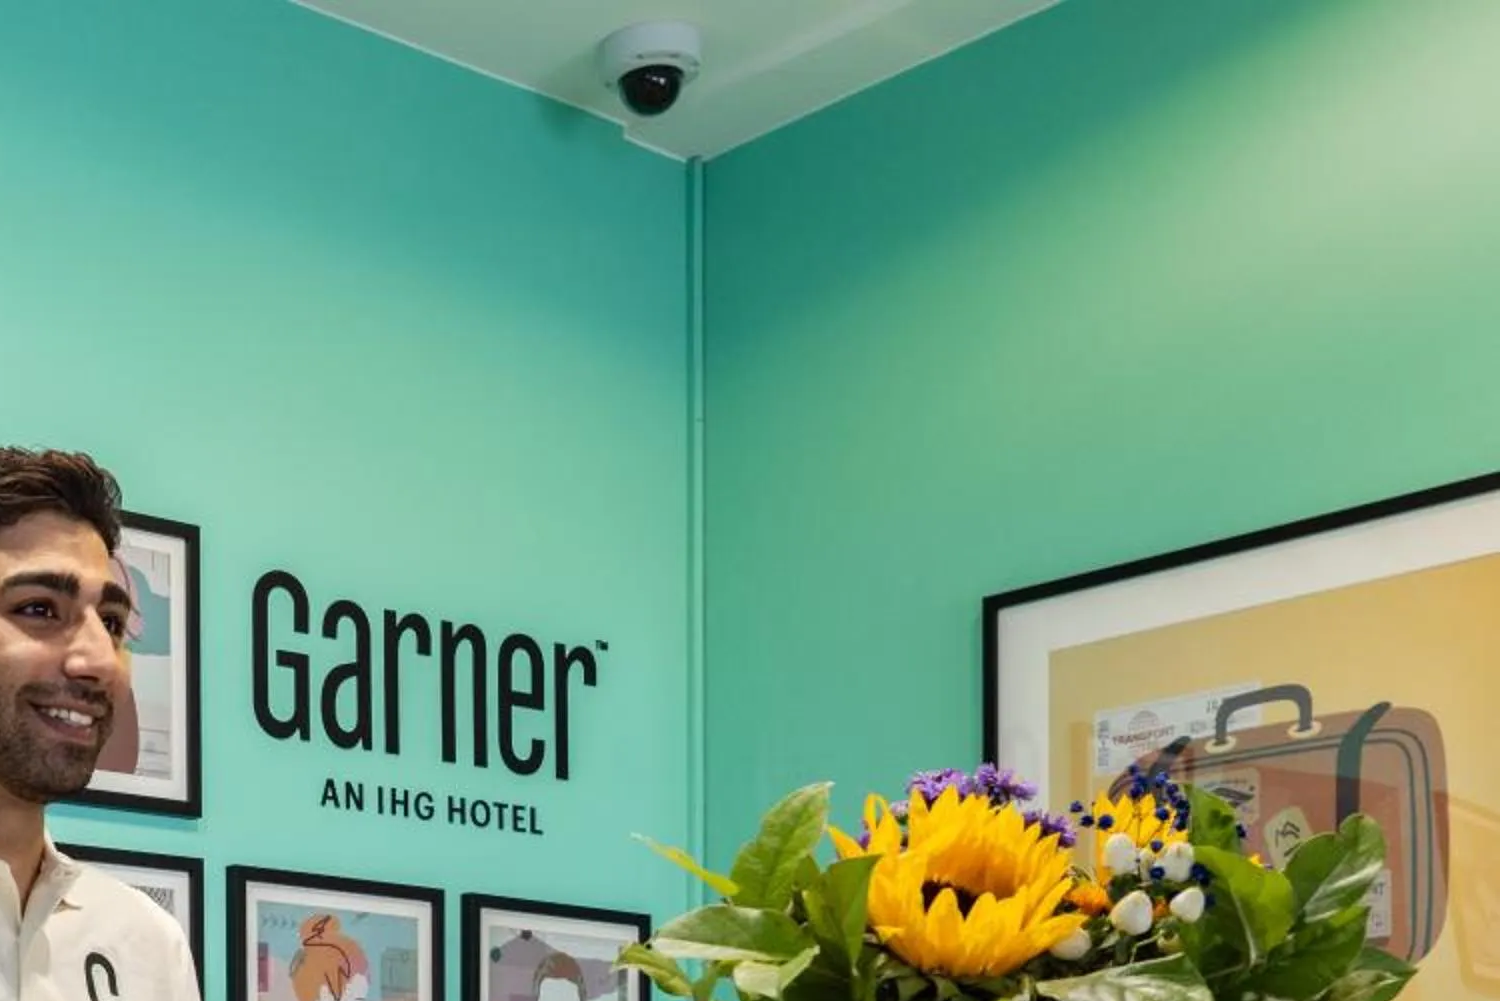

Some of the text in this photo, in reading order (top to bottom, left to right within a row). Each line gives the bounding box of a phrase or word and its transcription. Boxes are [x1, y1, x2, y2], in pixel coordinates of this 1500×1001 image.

[320, 778, 543, 835] AN IHG HOTEL
